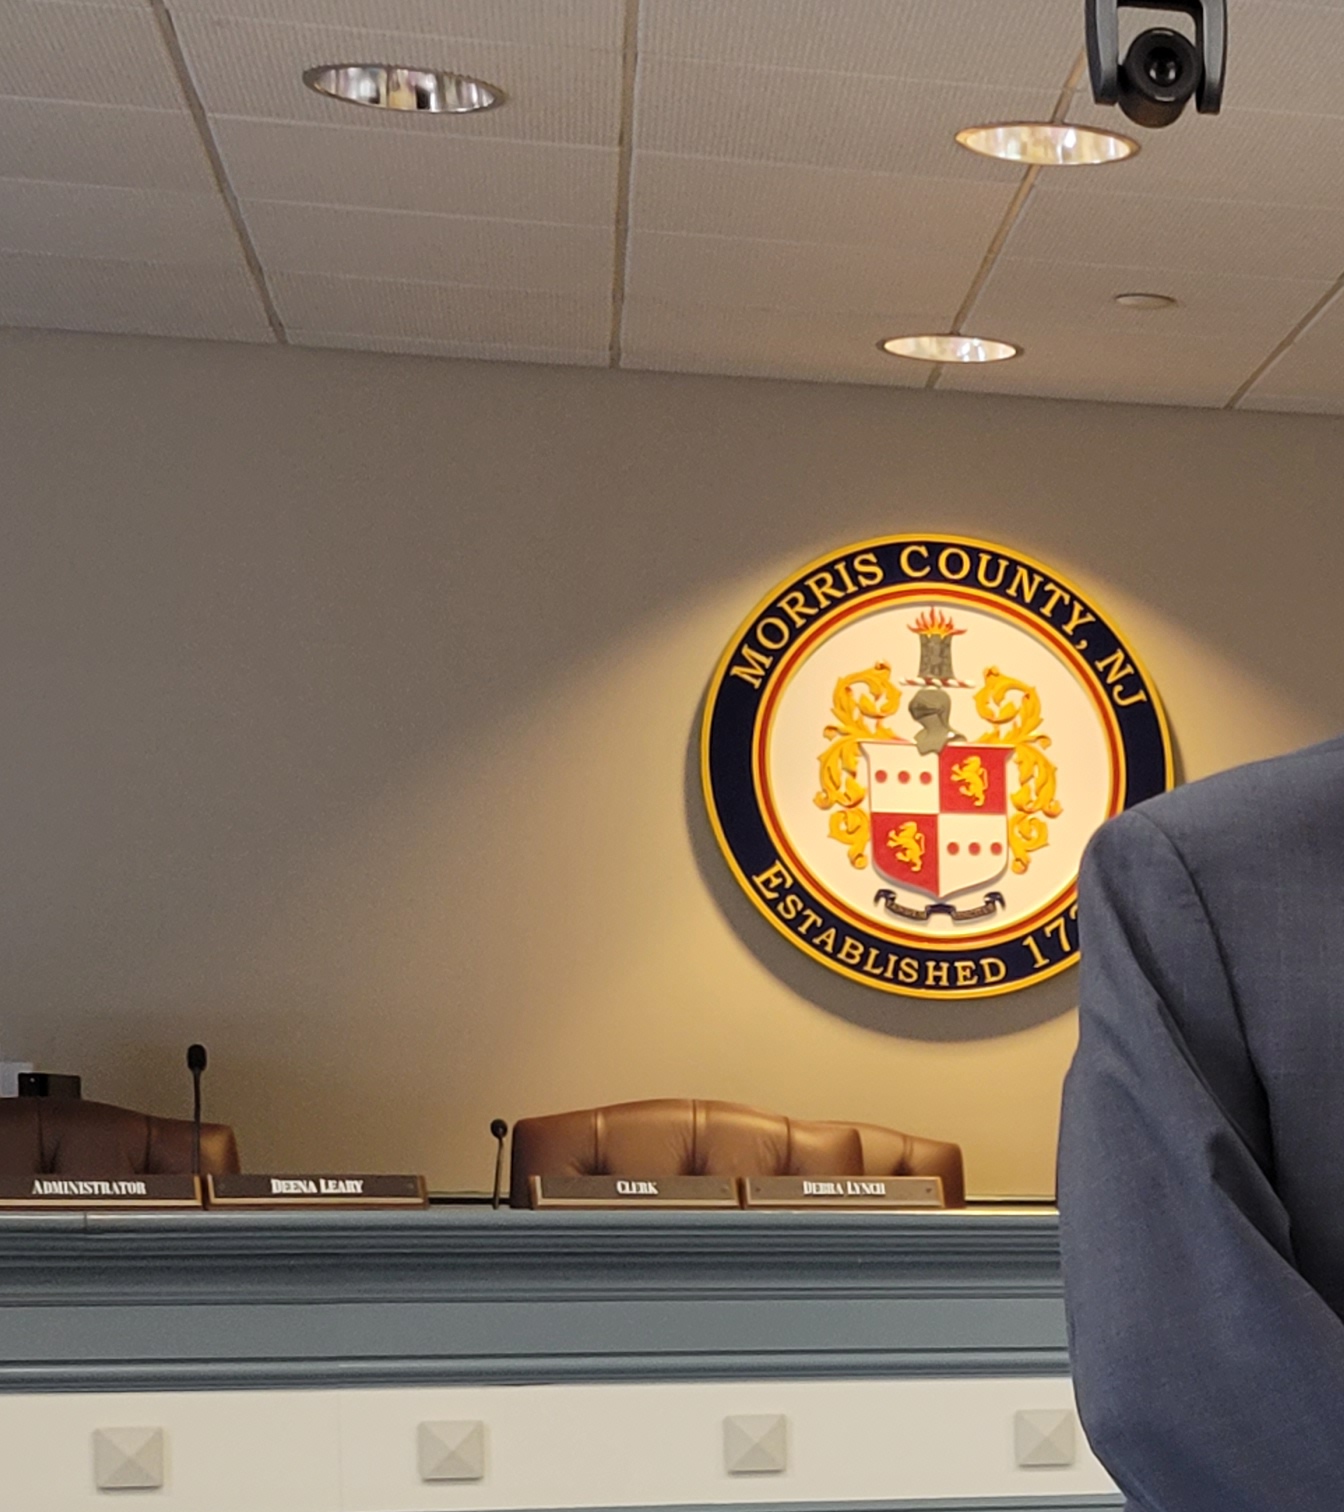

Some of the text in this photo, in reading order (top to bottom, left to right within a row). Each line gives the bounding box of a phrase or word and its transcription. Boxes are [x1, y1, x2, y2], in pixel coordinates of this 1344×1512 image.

[731, 545, 1146, 707] MORRIS COUNTY, NJ
[752, 860, 1008, 986] ESTABLISHED
[32, 1178, 147, 1196] ADMINISTRATOR
[270, 1178, 364, 1194] DEENA LEARY
[616, 1180, 658, 1195] CLERK
[803, 1181, 886, 1196] DEBRA LYNCH
